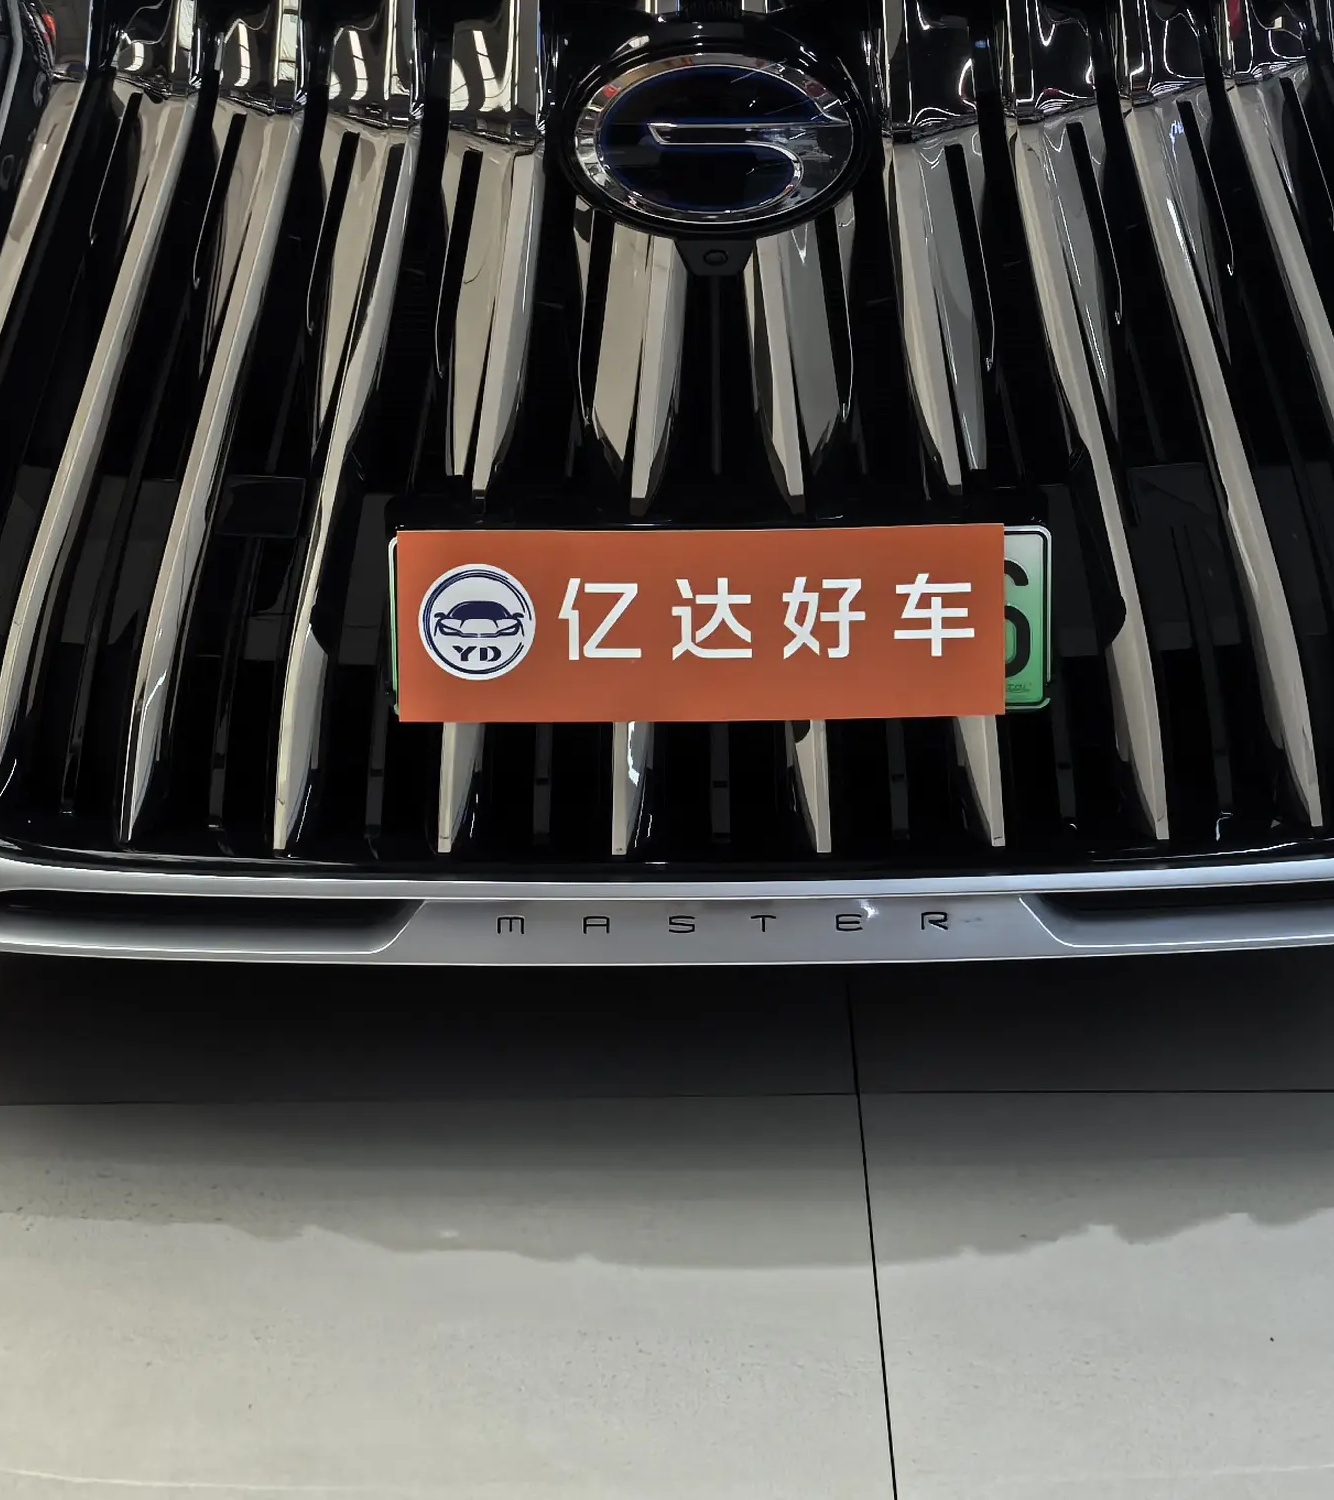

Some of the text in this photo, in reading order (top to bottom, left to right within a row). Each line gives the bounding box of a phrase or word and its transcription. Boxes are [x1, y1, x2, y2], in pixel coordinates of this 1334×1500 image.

[558, 572, 976, 661] 亿达好车
[452, 645, 503, 663] YD
[495, 910, 951, 936] MASTER
